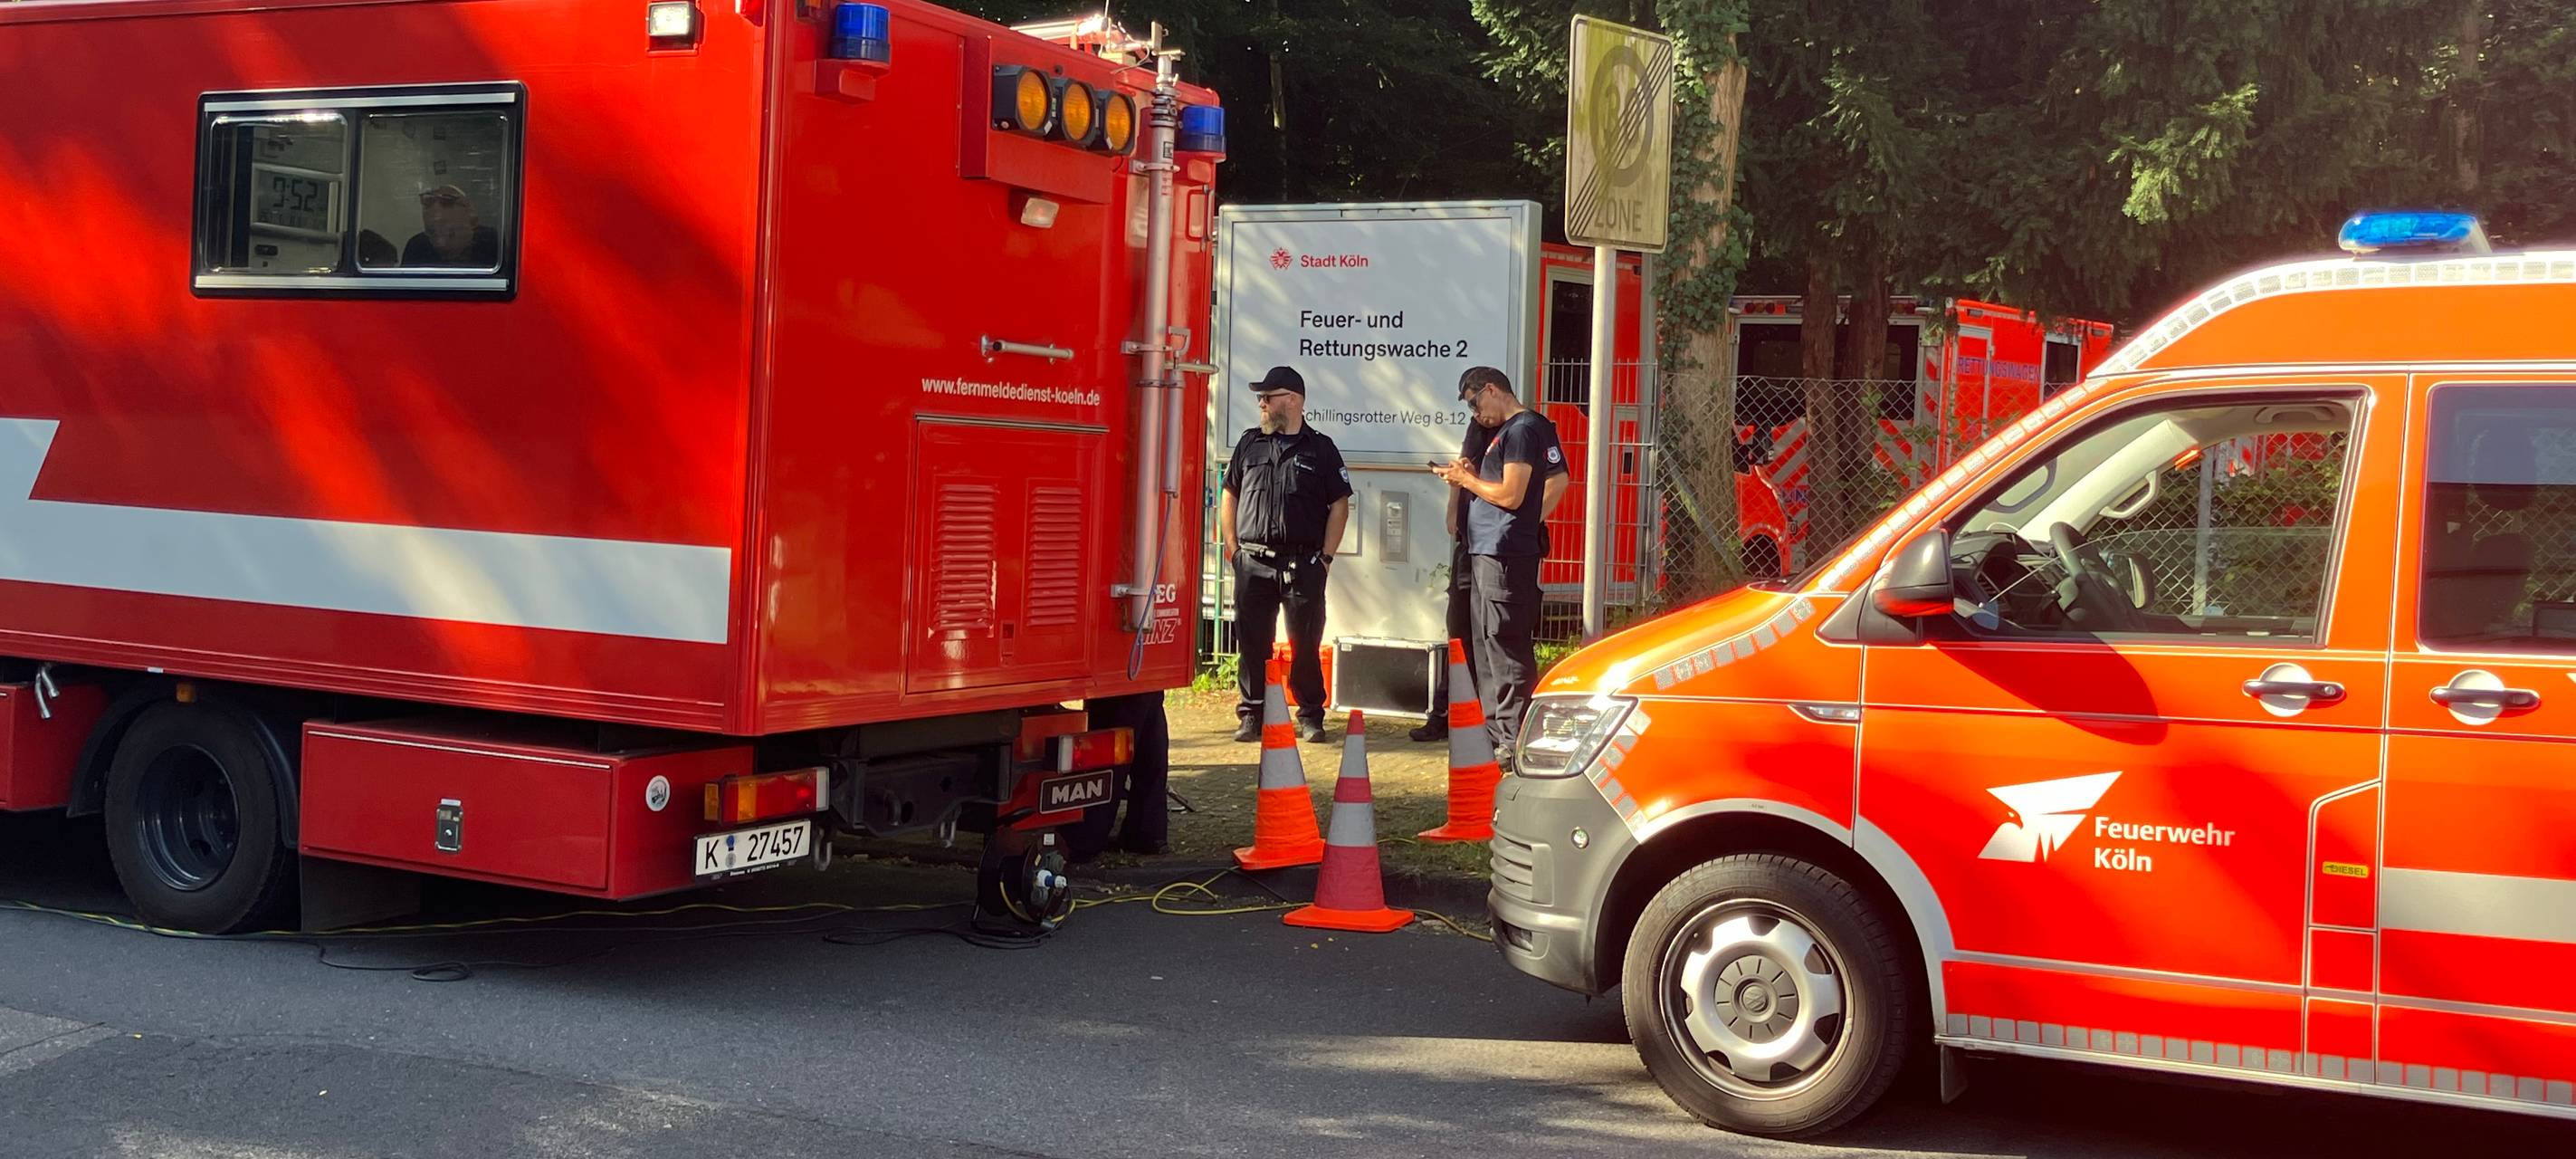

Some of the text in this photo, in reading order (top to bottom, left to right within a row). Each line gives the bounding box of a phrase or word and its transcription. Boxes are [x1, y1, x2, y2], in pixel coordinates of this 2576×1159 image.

[1595, 199, 1642, 232] ZONE
[1300, 254, 1369, 268] Stadt Köln
[1300, 311, 1404, 329] Feuer- und
[1299, 339, 1468, 361] Rettungswache 2
[921, 377, 1101, 407] www.fernmeldedienst-koeln.de
[1305, 409, 1466, 427] chillingsrotter Weg 8-12
[1155, 583, 1177, 604] EG
[1051, 779, 1103, 805] MAN
[2094, 815, 2236, 847] Feuerwehr
[704, 825, 805, 870] K 27457
[2094, 847, 2152, 873] Köln
